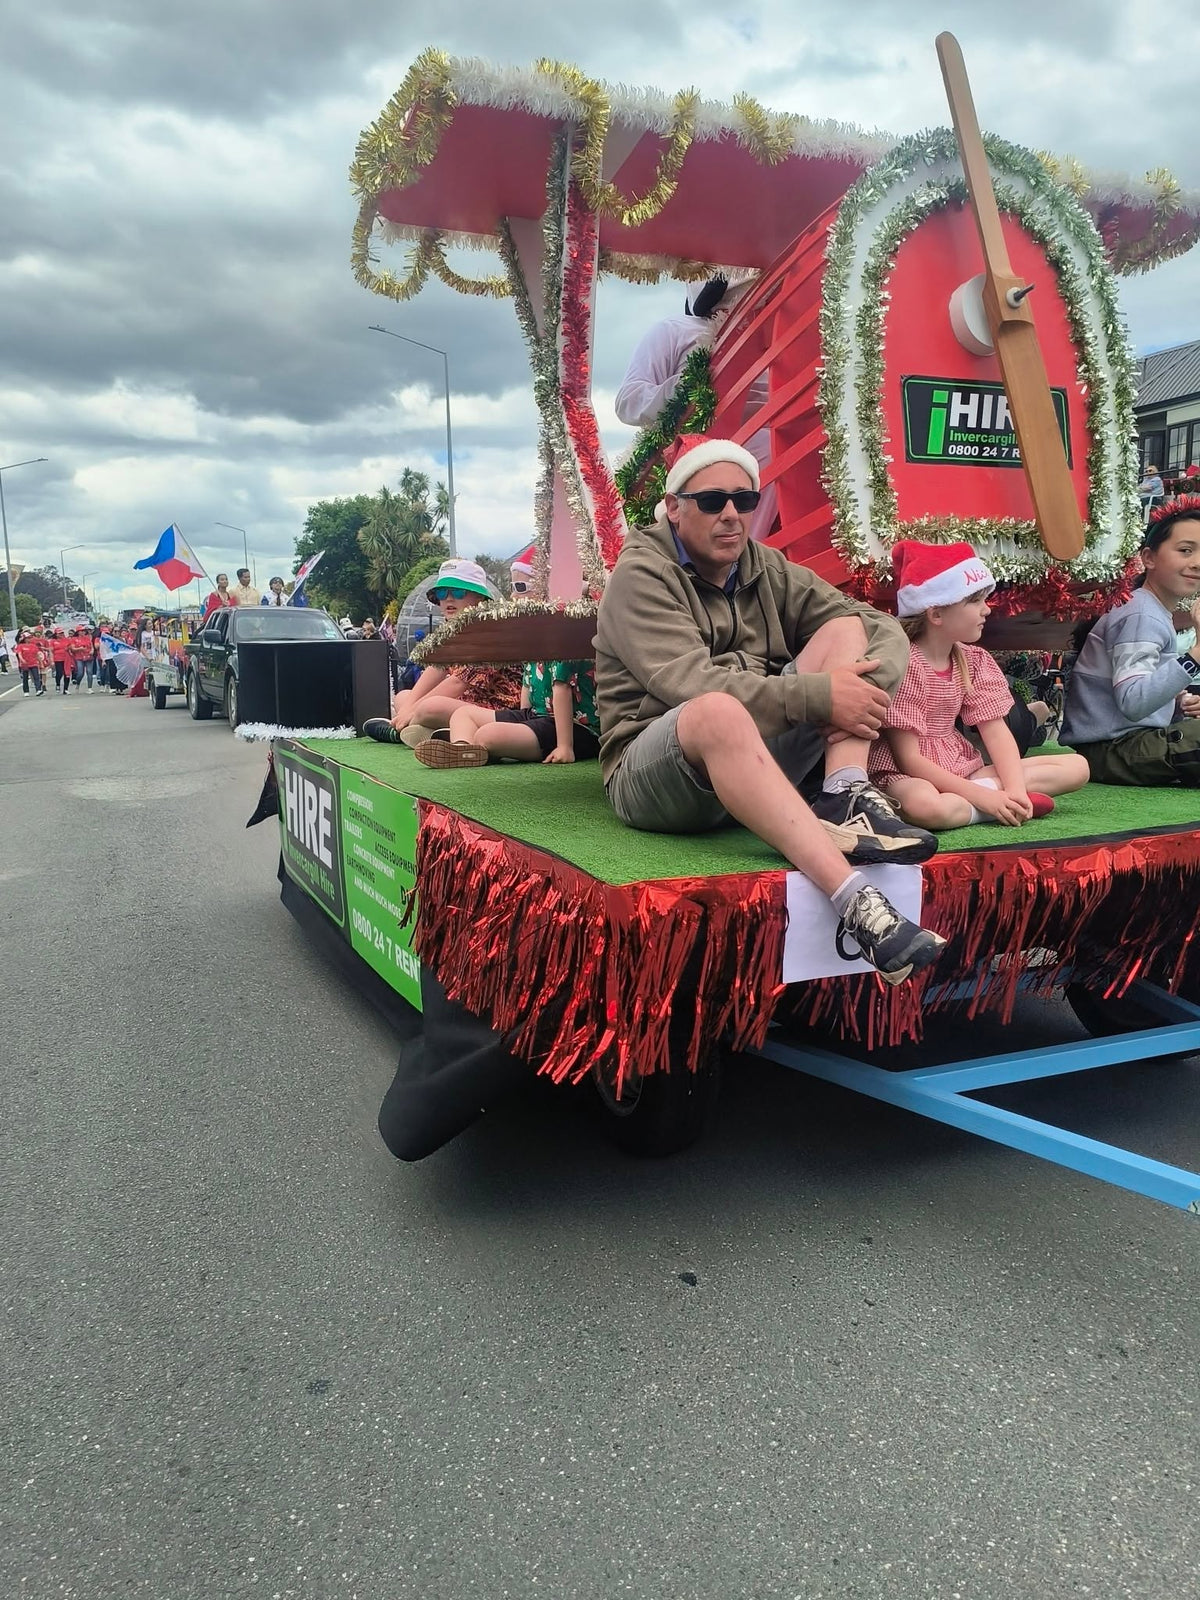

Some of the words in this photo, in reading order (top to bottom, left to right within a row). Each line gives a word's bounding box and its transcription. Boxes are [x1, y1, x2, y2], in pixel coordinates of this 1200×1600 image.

[927, 390, 1015, 454] iHIR
[948, 445, 979, 456] 0800
[982, 447, 997, 457] 24
[1001, 448, 1009, 457] 7
[344, 819, 362, 839] TRAILERS
[373, 821, 395, 843] EQUIPMENT
[353, 843, 372, 863] CONCRETE
[372, 855, 394, 880] EQUIPMENT
[375, 842, 388, 859] ACCESS
[346, 854, 375, 883] EARTHMOVING
[320, 871, 335, 900] Hire
[352, 908, 371, 942] 0800
[374, 926, 384, 954] 24
[386, 937, 391, 960] 7
